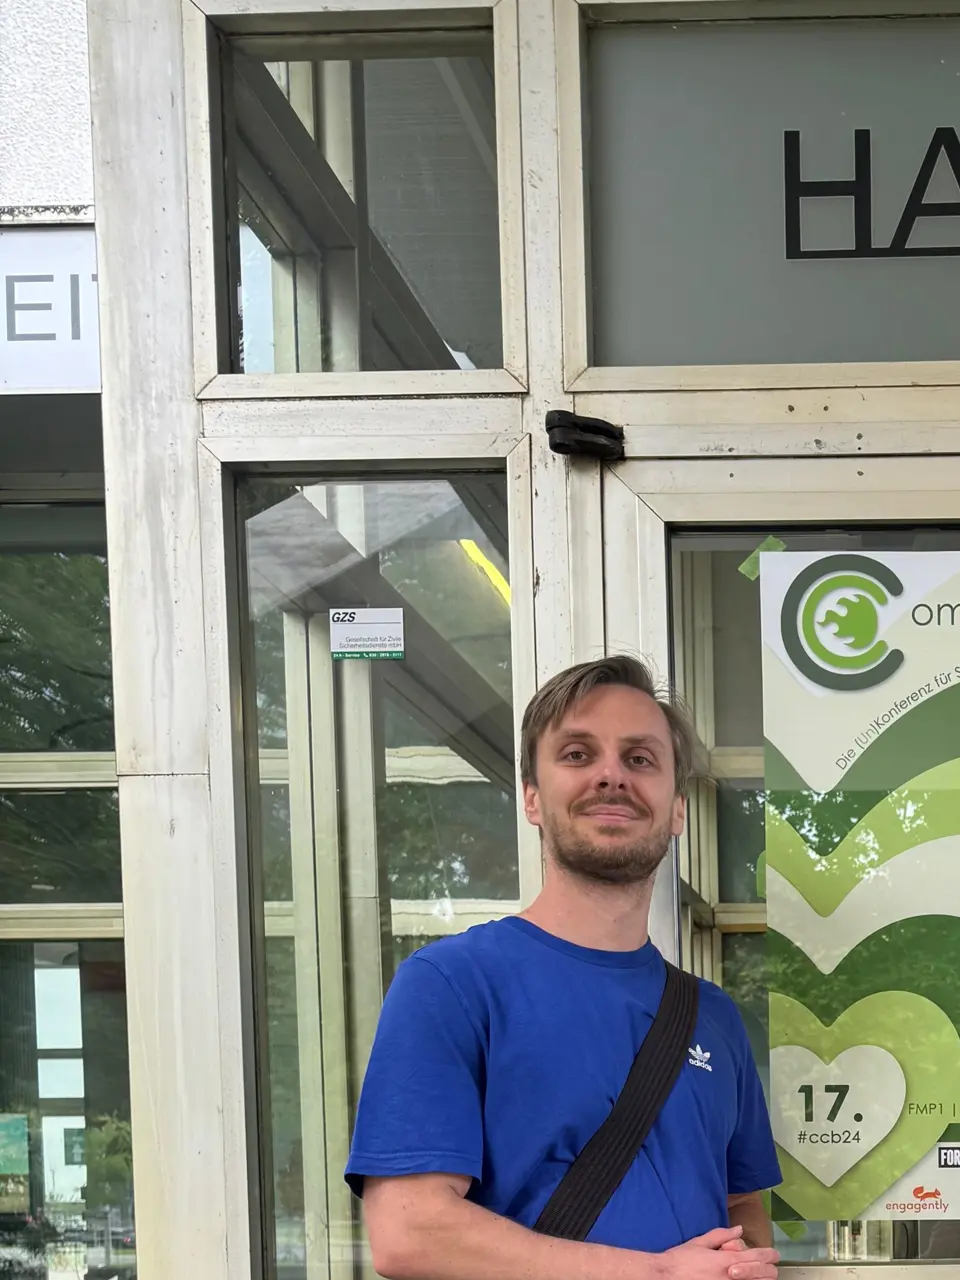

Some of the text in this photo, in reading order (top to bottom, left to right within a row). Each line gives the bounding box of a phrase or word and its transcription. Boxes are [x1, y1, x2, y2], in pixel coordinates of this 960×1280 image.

[6, 273, 98, 341] EI
[331, 611, 356, 623] GZS
[835, 748, 857, 771] Die
[854, 682, 934, 749] (Un)Konferenz
[933, 672, 953, 688] für
[688, 1058, 713, 1072] adidas
[797, 1084, 864, 1124] 17.
[908, 1102, 944, 1116] FMP1
[797, 1130, 861, 1144] #ccb24
[885, 1201, 950, 1214] engagently
